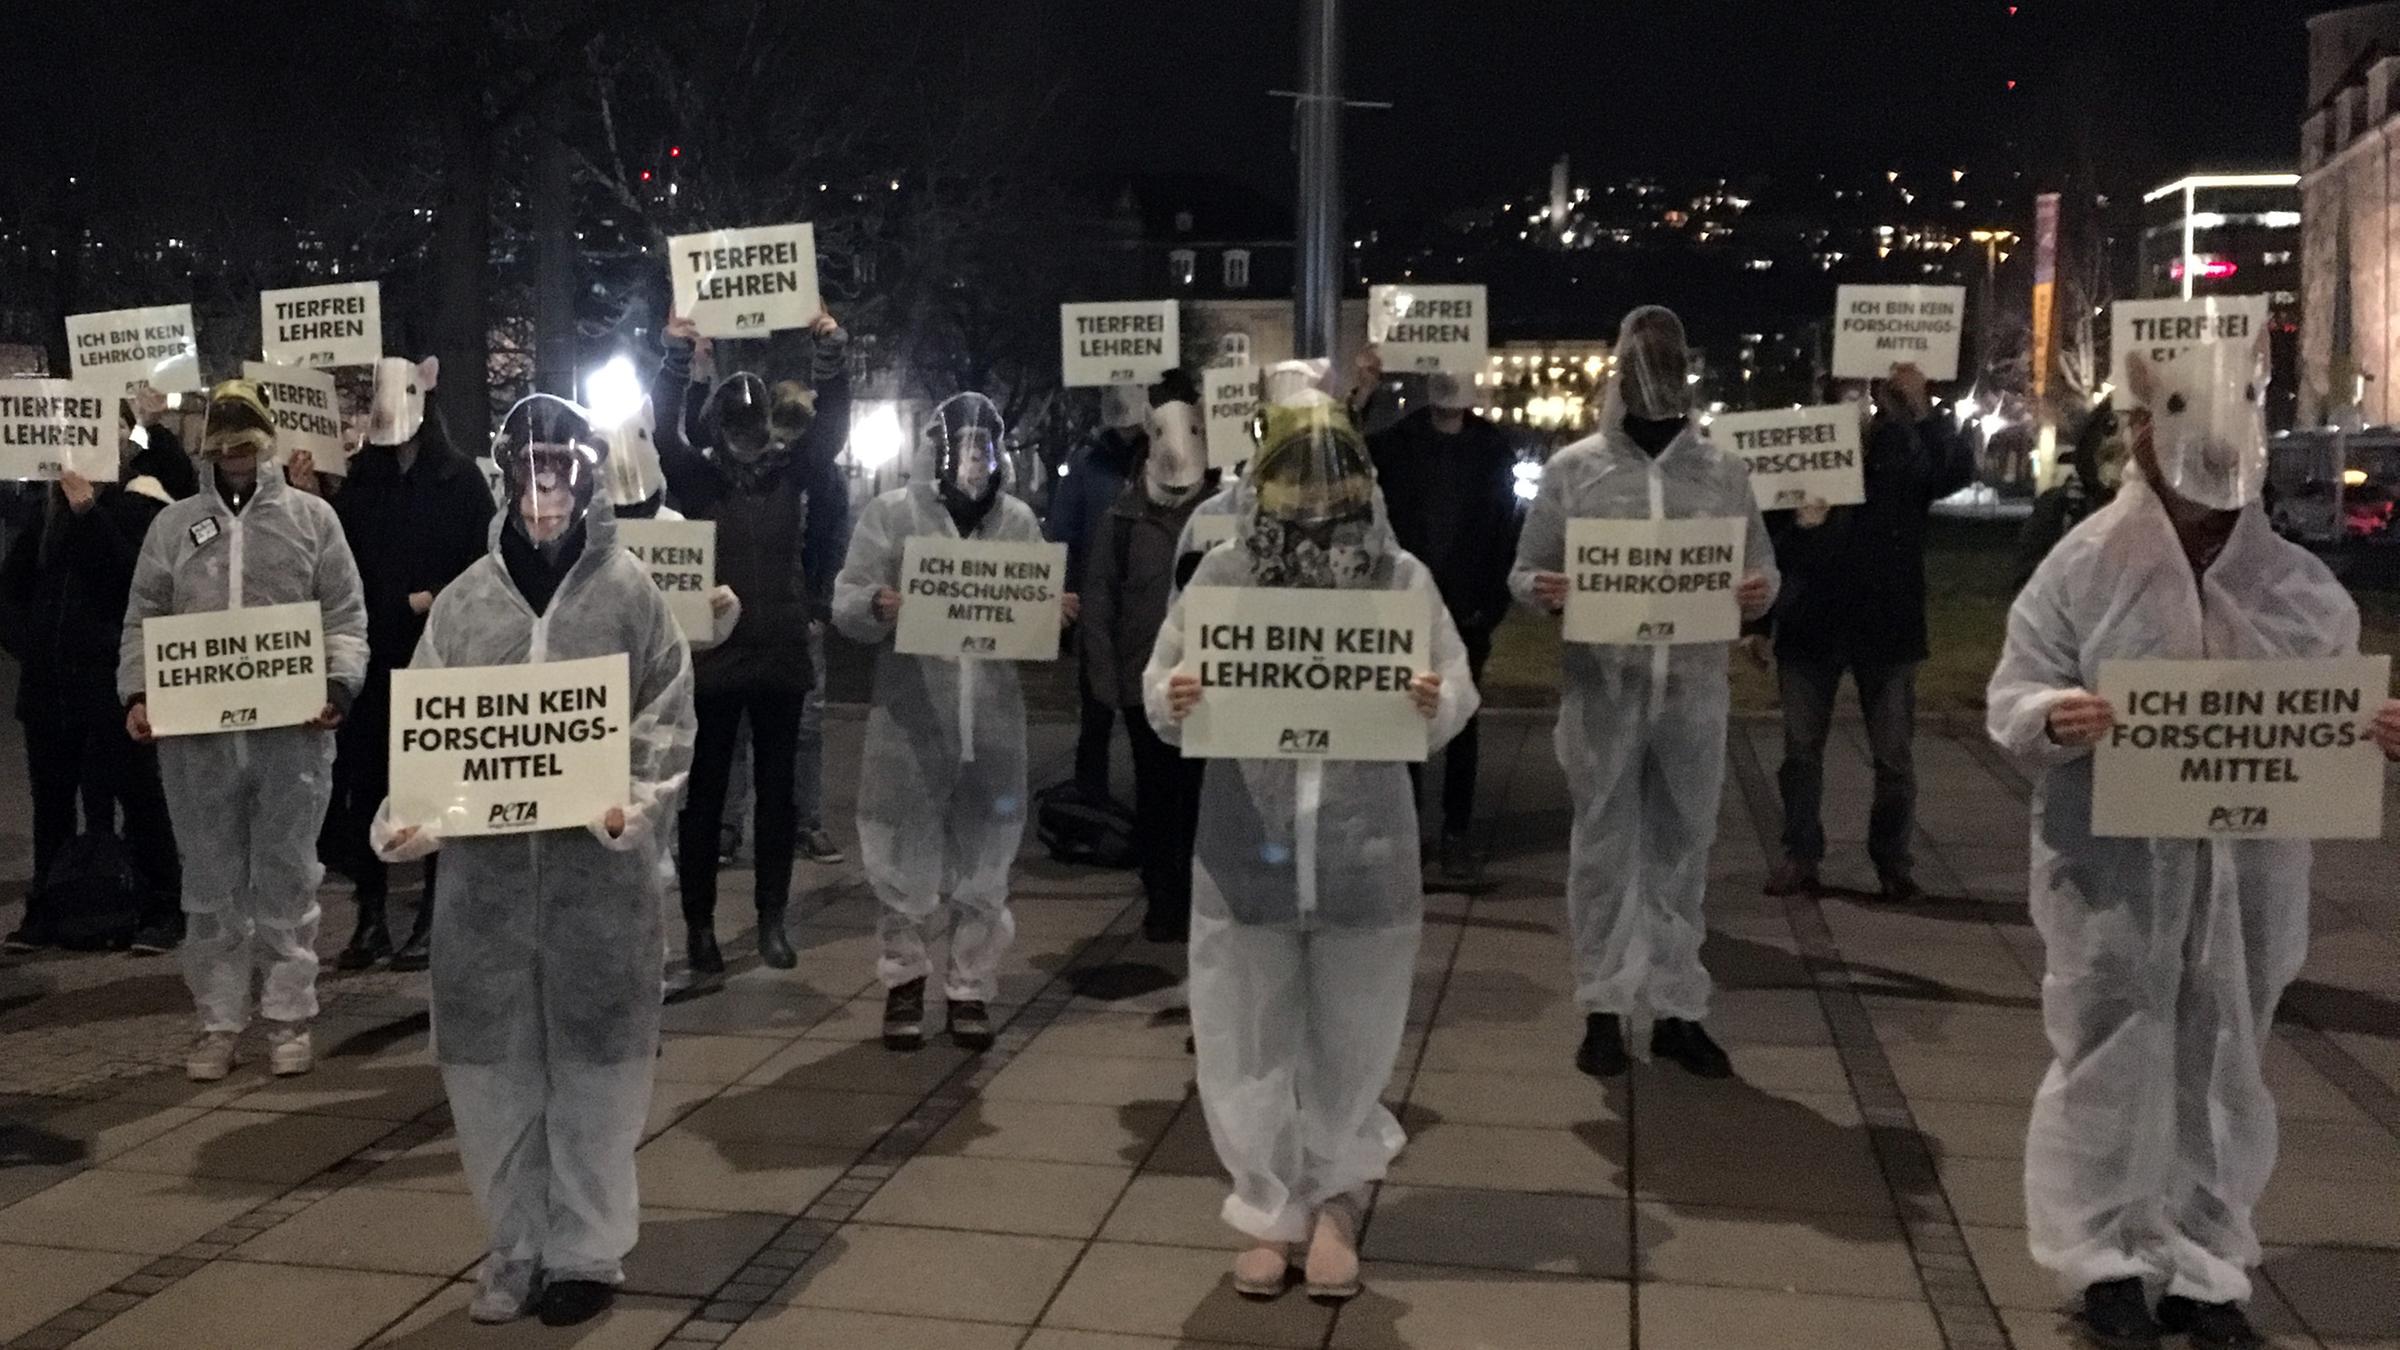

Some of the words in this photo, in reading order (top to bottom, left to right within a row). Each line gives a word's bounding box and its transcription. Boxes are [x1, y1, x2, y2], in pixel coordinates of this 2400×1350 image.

[688, 242, 798, 272] TIERFREI
[697, 271, 797, 301] LEHREN
[275, 296, 366, 322] TIERFREI
[1851, 302, 1880, 315] ICH
[1886, 302, 1915, 315] BIN
[1920, 302, 1954, 315] KEIN
[77, 332, 105, 348] ICH
[110, 328, 139, 345] BIN
[145, 324, 185, 341] KEIN
[279, 319, 363, 342] LEHREN
[1077, 315, 1164, 334] TIERFREI
[1386, 324, 1470, 343] LEHREN
[1843, 319, 1957, 334] FORSCHUNGS-
[1080, 338, 1163, 357] LEHREN
[1876, 336, 1928, 351] MITTEL
[1, 397, 102, 421] TIERFREI
[4, 424, 99, 447] LEHREN
[269, 409, 338, 438] ORSCHEN
[1732, 423, 1836, 450] TIERFREI
[651, 546, 703, 566] KEIN
[920, 558, 954, 576] ICH
[961, 559, 998, 578] BIN
[1004, 561, 1051, 580] KEIN
[1577, 545, 1619, 566] ICH
[1628, 547, 1672, 567] BIN
[1680, 545, 1734, 566] KEIN
[908, 579, 1056, 602] FORSCHUNGS-
[1577, 568, 1732, 594] LEHRKÖRPER
[948, 603, 1015, 623] MITTEL
[157, 640, 197, 662] ICH
[206, 636, 247, 657] BIN
[255, 629, 312, 652] KEIN
[1201, 624, 1254, 651] ICH
[1266, 625, 1323, 652] BIN
[1336, 628, 1413, 655] KEIN
[158, 656, 313, 688] LEHRKÖRPER
[1201, 656, 1413, 692] LEHRKÖRPER
[415, 696, 465, 720] ICH
[477, 693, 529, 719] BIN
[540, 685, 607, 715] KEIN
[2128, 690, 2188, 716] ICH
[2200, 690, 2265, 716] BIN
[2277, 688, 2360, 714] KEIN
[403, 717, 619, 752] FORSCHUNGS-
[2111, 721, 2372, 749] FORSCHUNGS-
[463, 753, 563, 781] MITTEL
[2180, 757, 2300, 783] MITTEL
